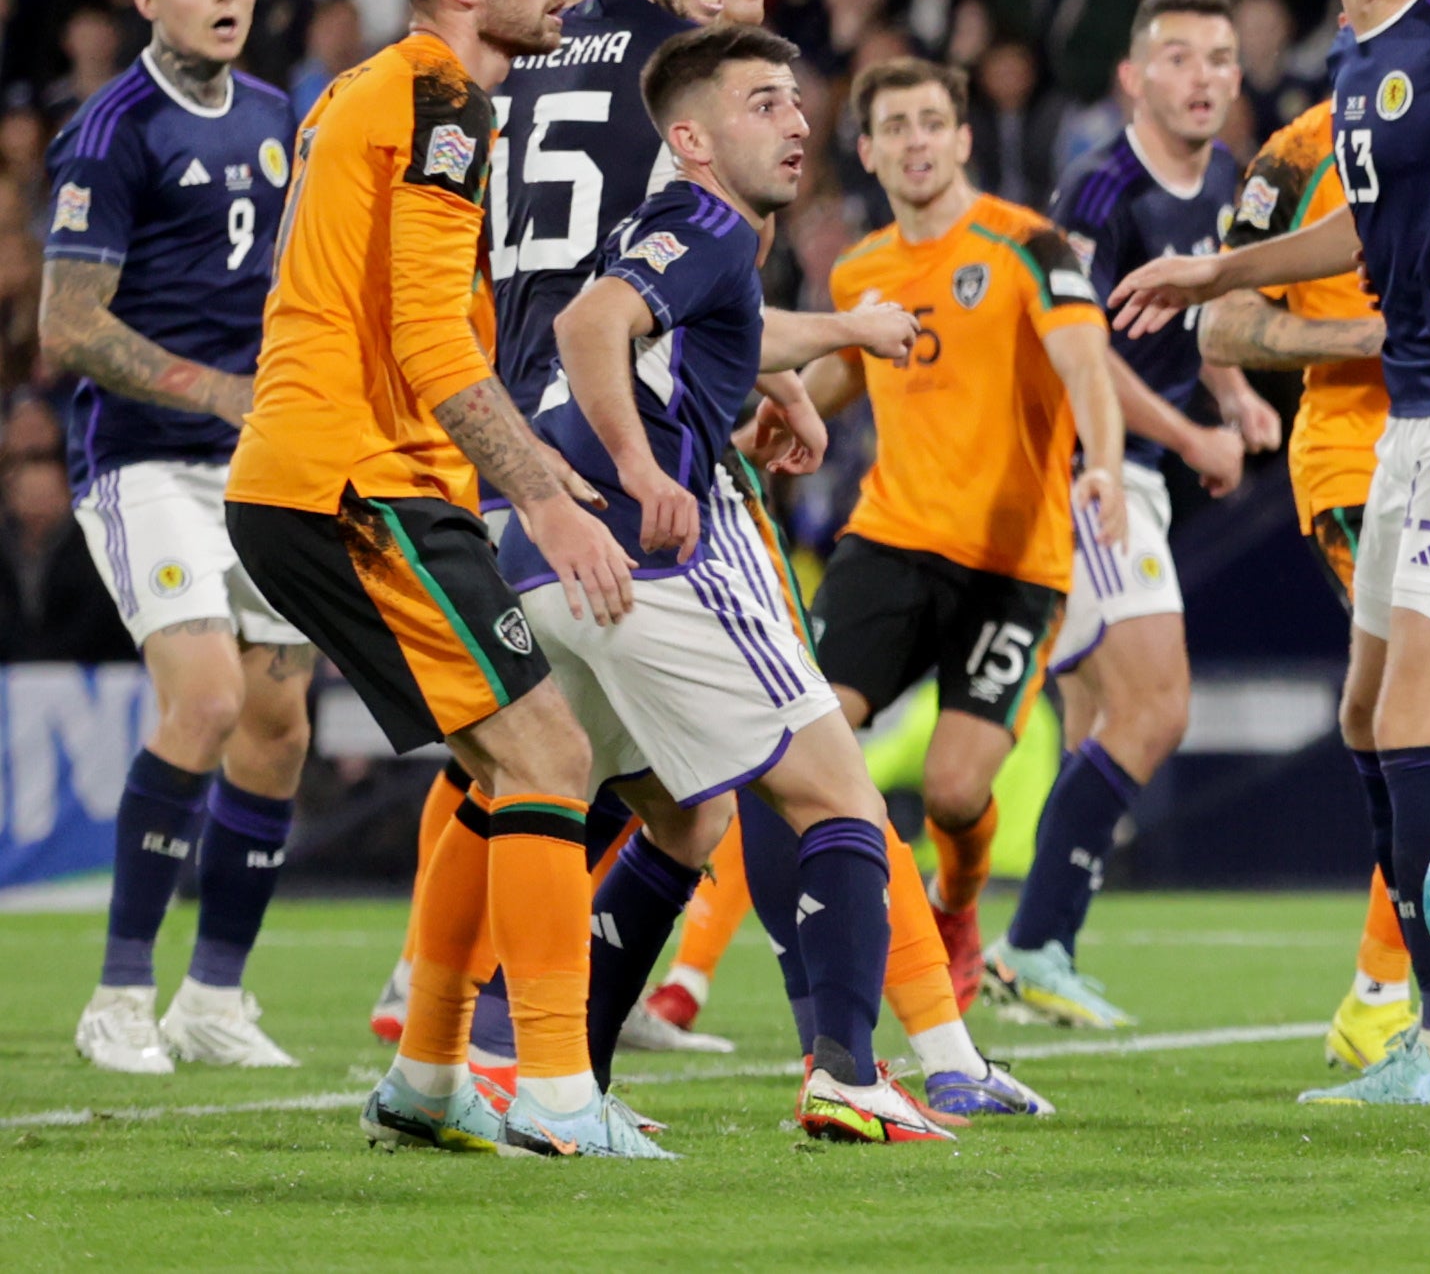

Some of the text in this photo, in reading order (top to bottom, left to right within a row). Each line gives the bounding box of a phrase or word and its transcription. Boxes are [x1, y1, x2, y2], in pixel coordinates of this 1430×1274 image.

[488, 90, 613, 281] 15
[1334, 128, 1380, 204] 13
[226, 196, 256, 271] 9
[965, 620, 1035, 686] 15
